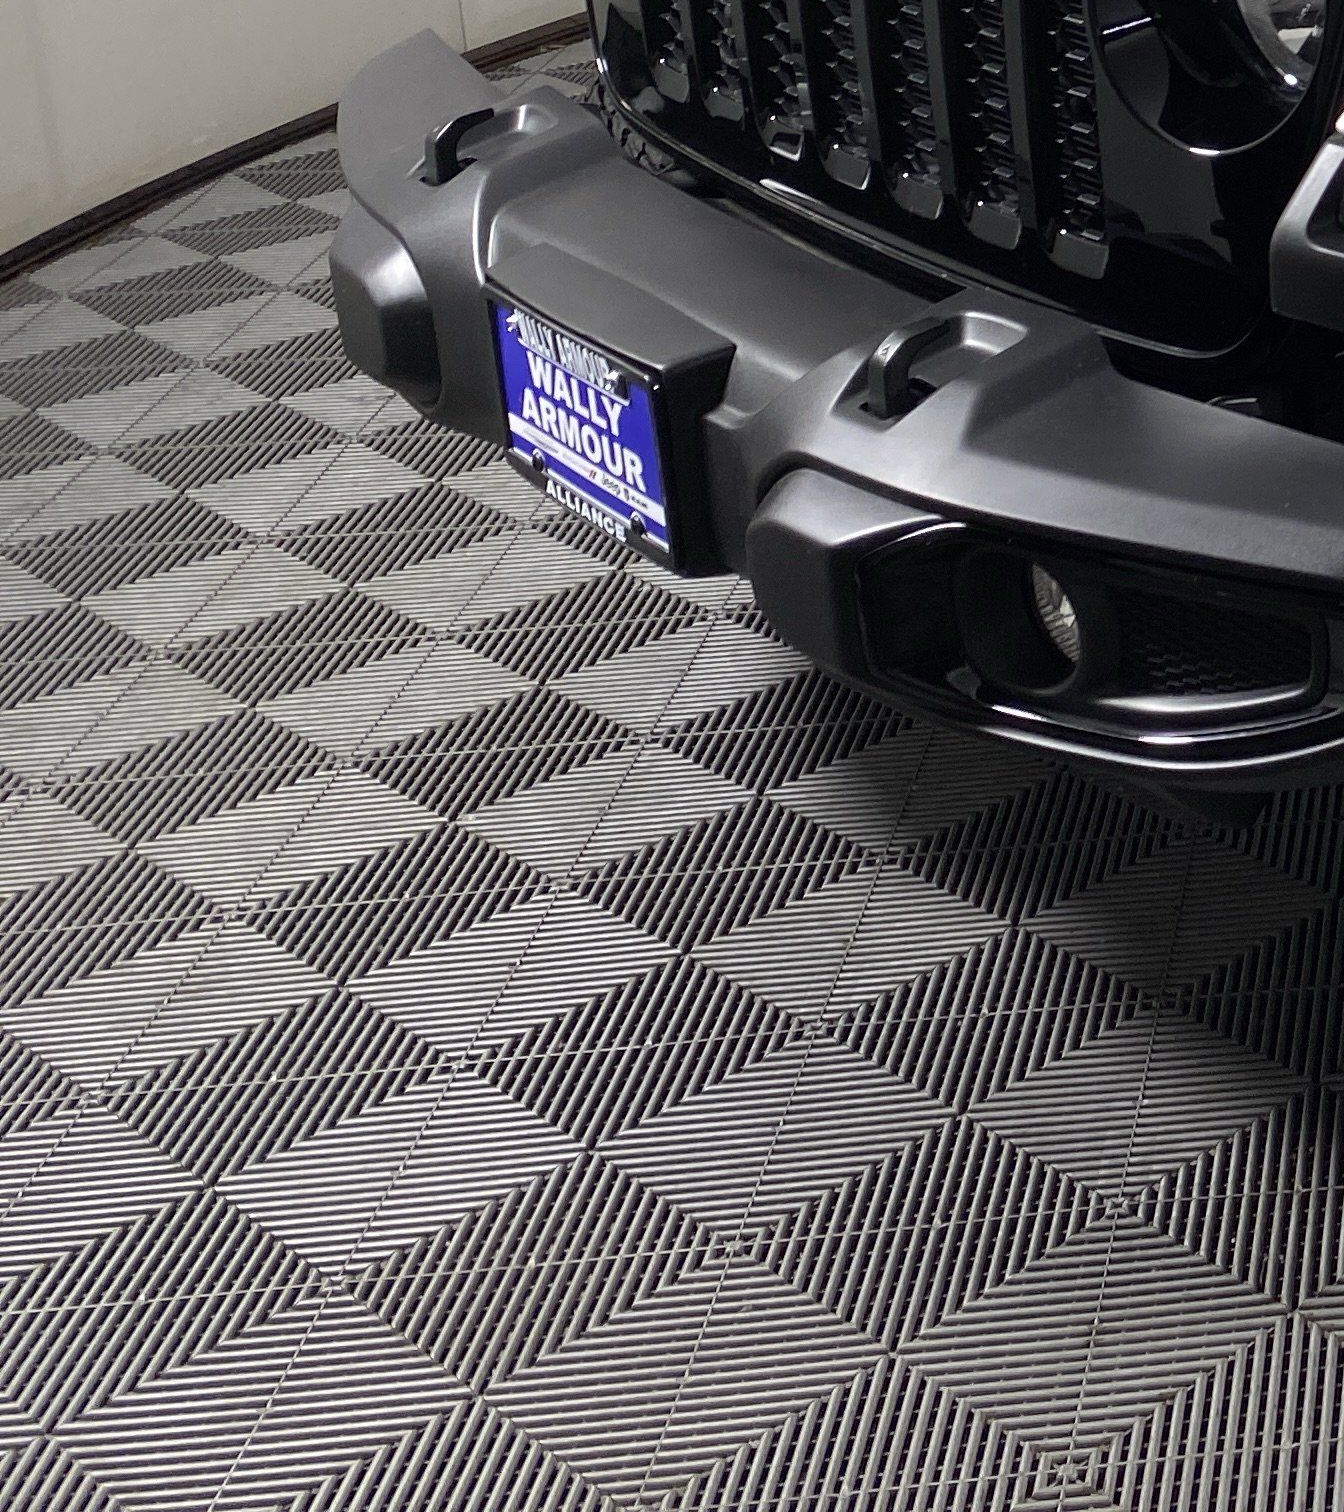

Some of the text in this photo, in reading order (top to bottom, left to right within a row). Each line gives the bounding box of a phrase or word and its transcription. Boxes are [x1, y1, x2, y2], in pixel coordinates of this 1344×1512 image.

[526, 350, 623, 437] WALLY
[522, 388, 646, 493] ARMOUR
[546, 479, 626, 543] ALLIANCE
